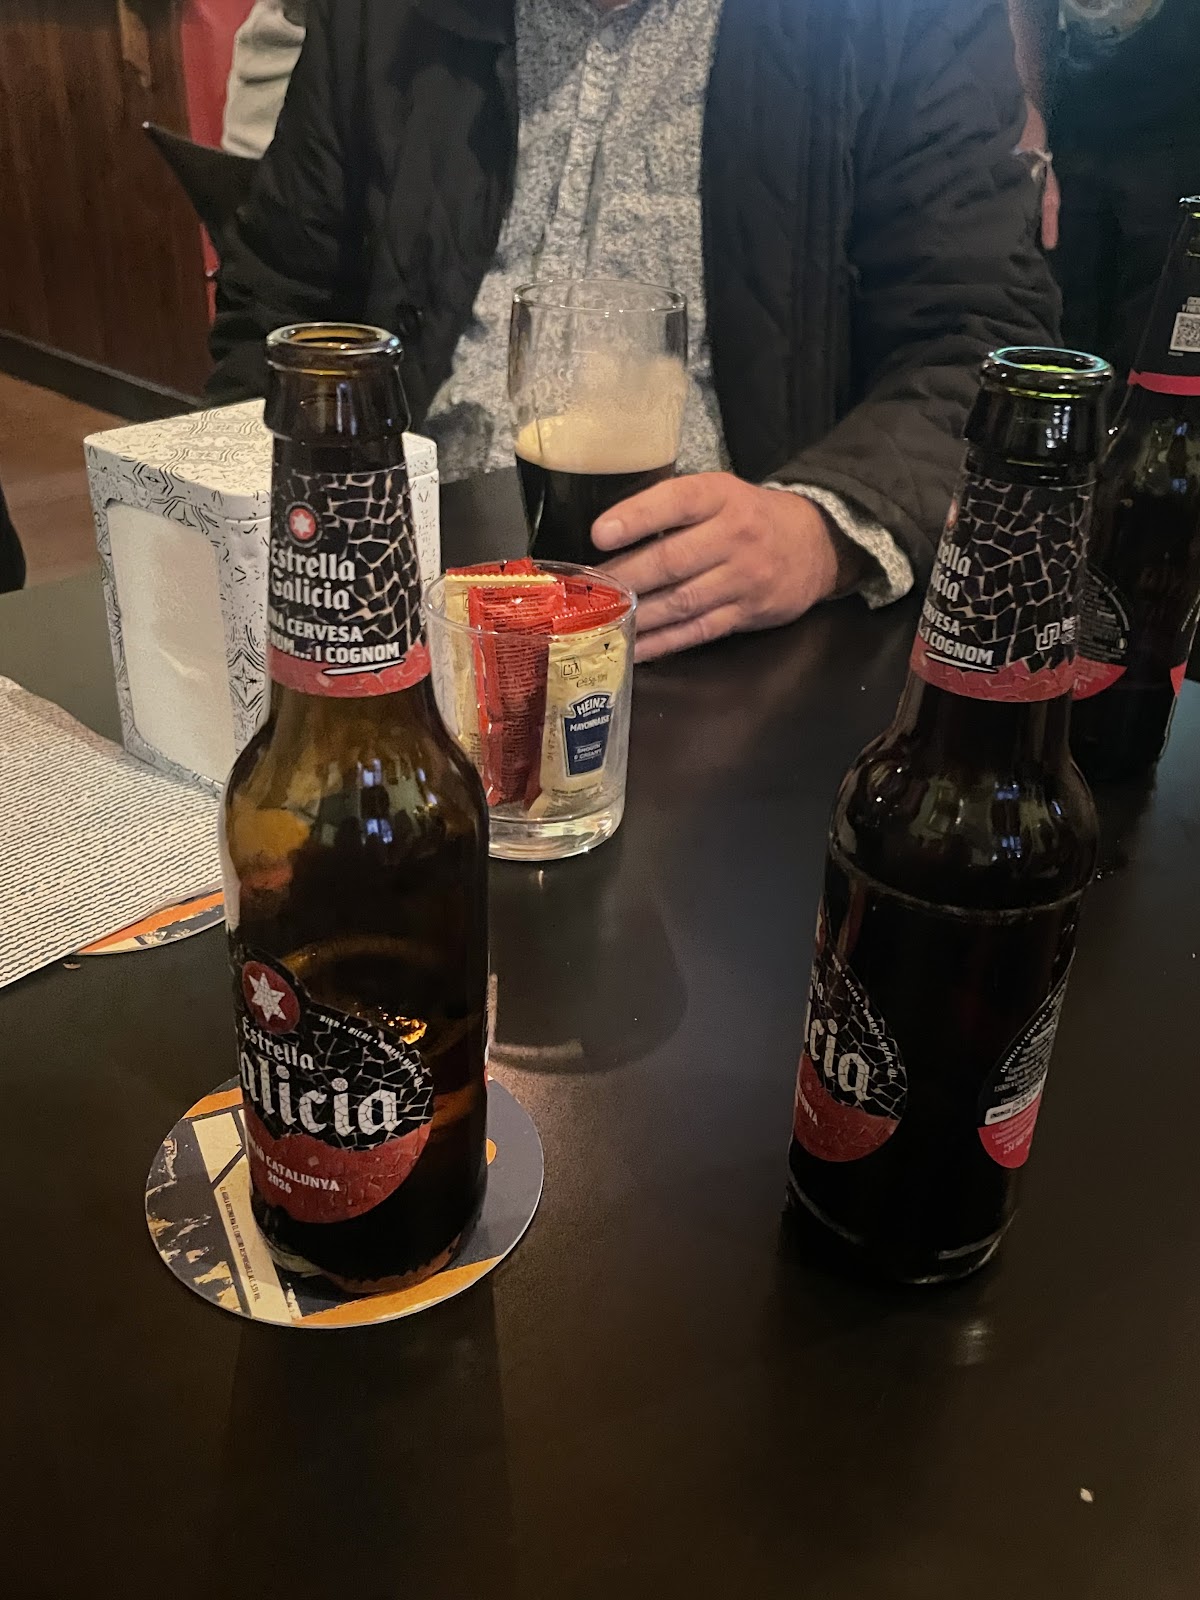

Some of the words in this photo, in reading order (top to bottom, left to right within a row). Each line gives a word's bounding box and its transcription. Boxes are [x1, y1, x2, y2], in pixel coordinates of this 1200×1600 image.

[270, 539, 356, 581] Estrella
[271, 567, 350, 611] Galicia
[287, 618, 364, 643] CERVESA
[928, 632, 995, 666] COGNOM
[314, 645, 322, 662] I
[325, 641, 399, 664] COGNOM
[576, 697, 607, 716] HEINZ
[242, 1016, 316, 1071] Estrella
[804, 984, 873, 1102] icia
[240, 1051, 403, 1138] alicia
[265, 1155, 340, 1192] CATALUNYA
